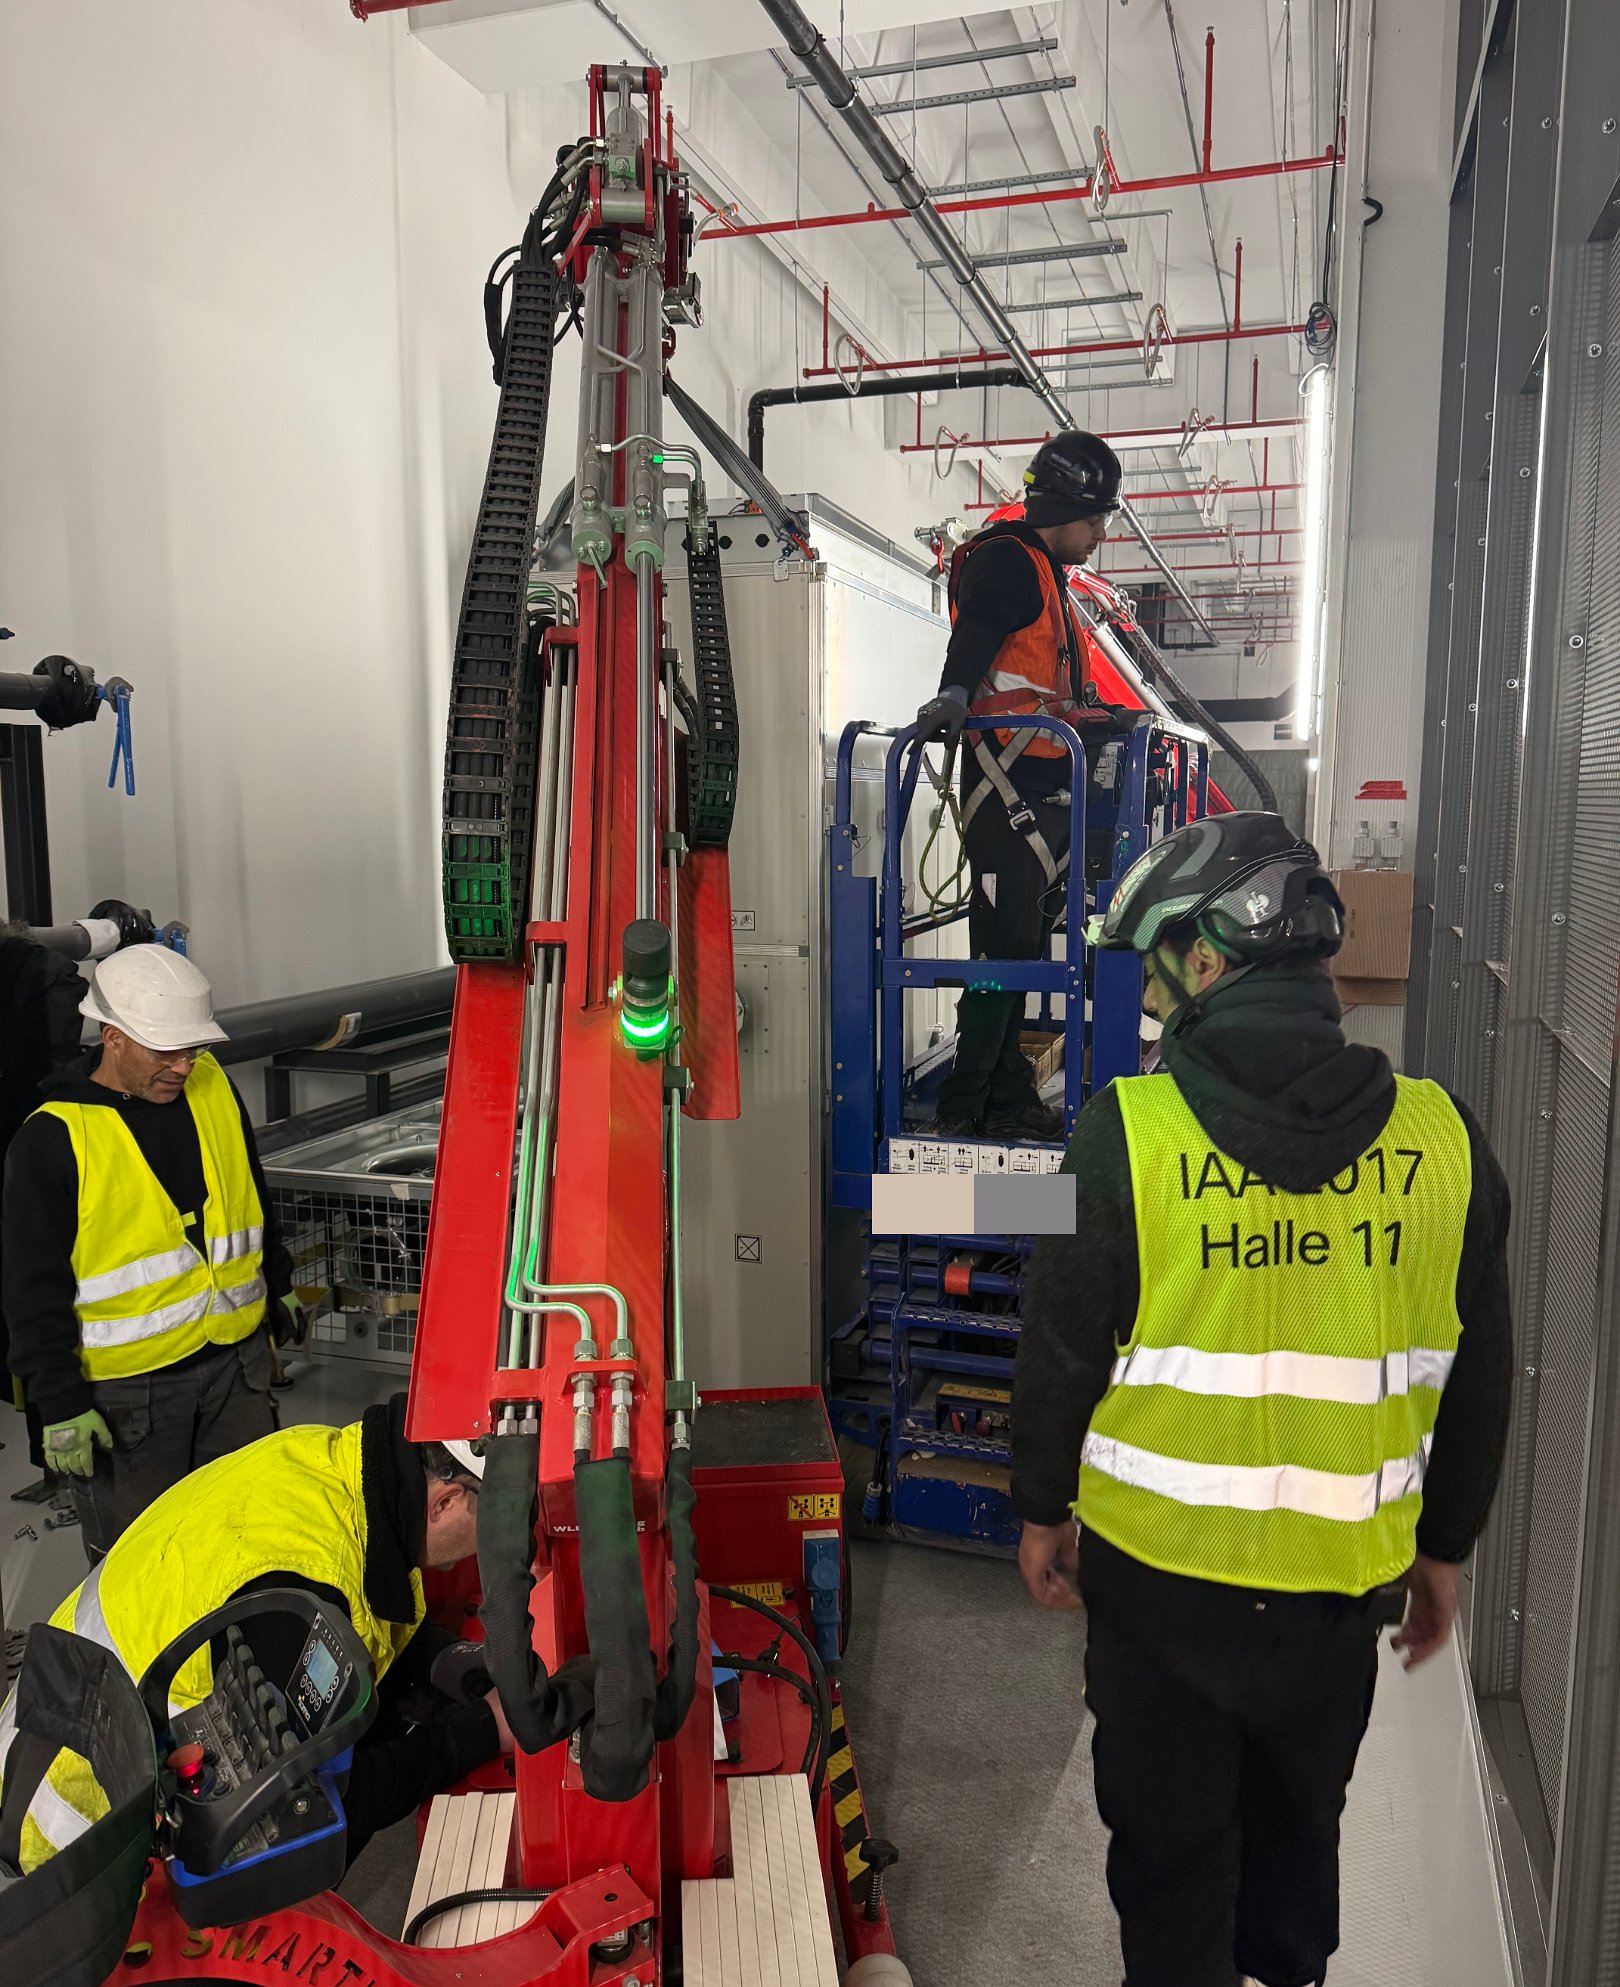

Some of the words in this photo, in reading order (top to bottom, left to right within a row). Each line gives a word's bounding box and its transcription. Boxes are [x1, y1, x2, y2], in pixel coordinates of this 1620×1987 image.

[1201, 1219, 1330, 1270] Halle
[1352, 1220, 1402, 1268] 11
[180, 1923, 376, 1987] SMART
